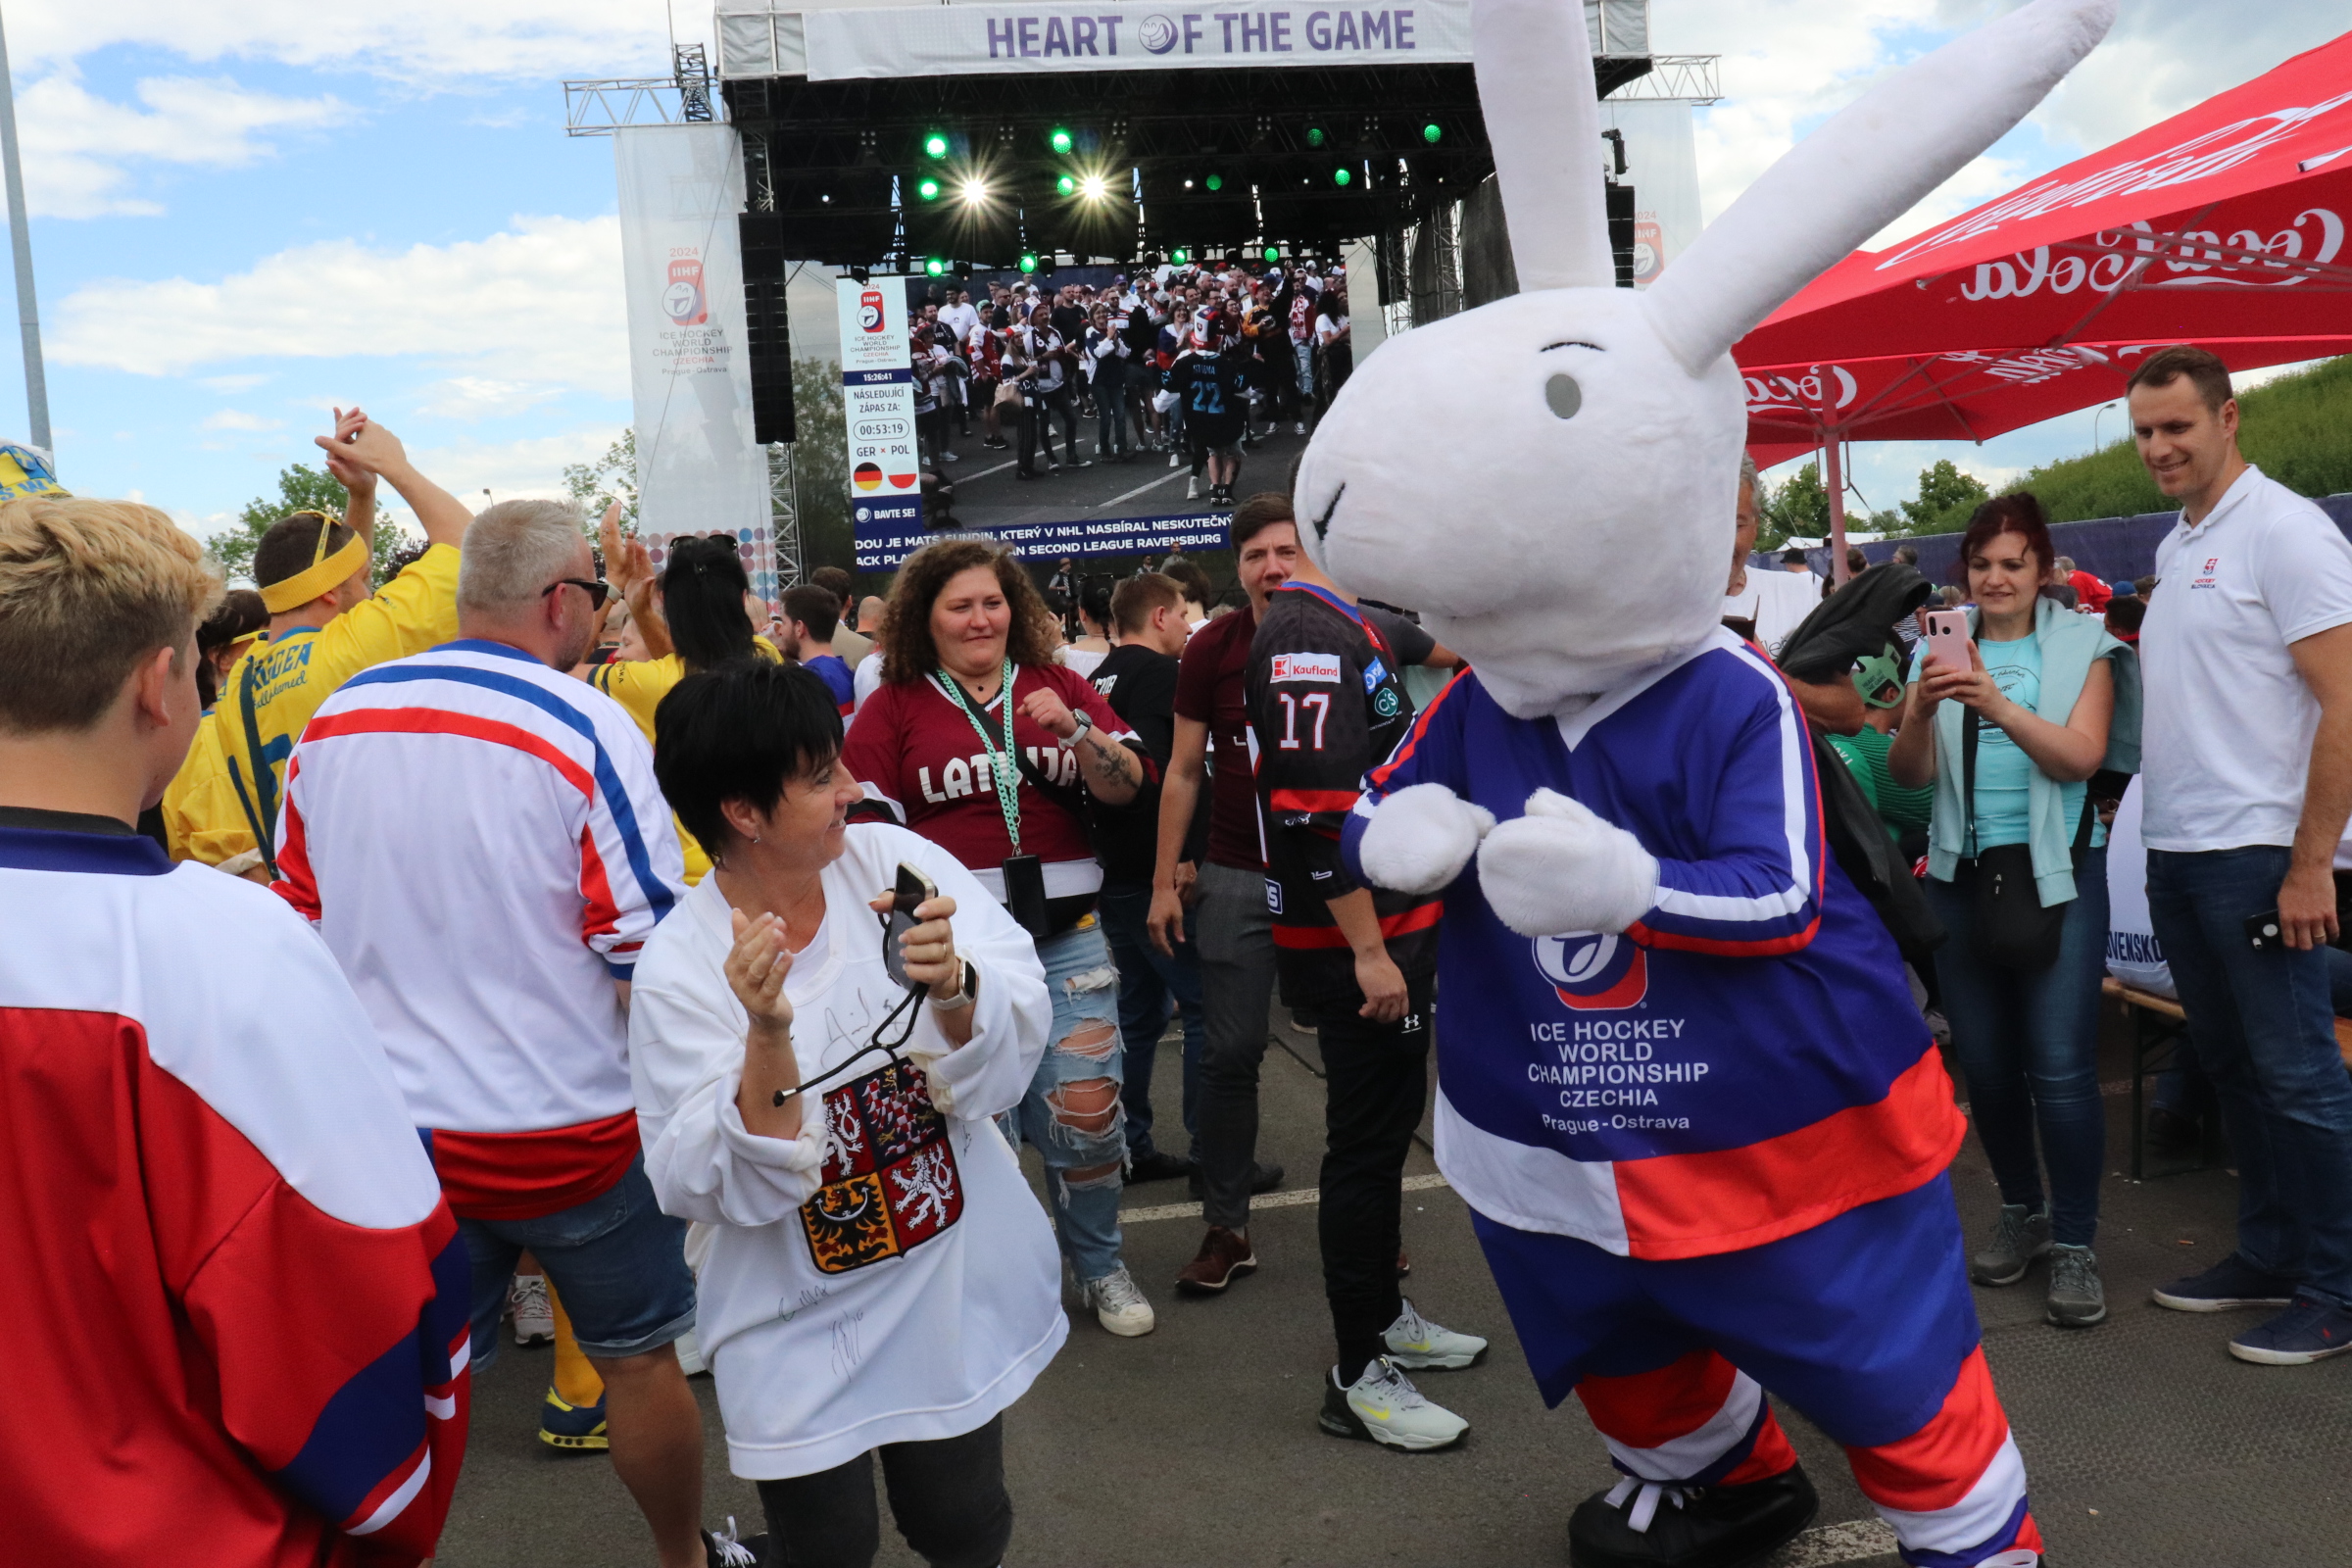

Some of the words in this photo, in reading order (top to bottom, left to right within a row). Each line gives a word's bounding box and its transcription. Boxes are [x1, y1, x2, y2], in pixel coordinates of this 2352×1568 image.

[987, 16, 1123, 58] HEART
[1213, 12, 1293, 53] THE
[1305, 10, 1416, 51] GAME
[1634, 211, 1657, 220] 024
[669, 247, 699, 257] 2024
[672, 266, 700, 277] IIHF
[660, 331, 677, 340] ICE
[679, 329, 723, 339] HOCKEY
[672, 338, 711, 348] WORLD
[652, 346, 733, 357] CHAMPIONSHIP
[672, 356, 715, 366] CZECHIA
[862, 372, 893, 382] 15:26:41
[854, 385, 905, 400] NÁSLEDUJÍCÍ
[1190, 380, 1225, 415] 22
[858, 402, 886, 414] ZÁPAS
[887, 403, 902, 412] ZA:
[859, 423, 904, 435] 00:53:19
[856, 446, 876, 457] GER
[891, 445, 910, 455] POL
[873, 509, 901, 520] BAVTE
[902, 508, 916, 518] SE!
[885, 537, 902, 548] JE
[905, 534, 941, 547] MATS
[1000, 525, 1042, 540] KTERÝ
[1044, 527, 1054, 538] V
[1056, 526, 1084, 537] NHL
[1086, 520, 1150, 535] NASBÍRAL
[1152, 514, 1233, 531] NESKUTEČNÝ
[1028, 542, 1081, 556] SECOND
[1083, 538, 1134, 552] LEAGUE
[1137, 533, 1222, 548] RAVENSBURG
[1293, 664, 1338, 677] Kaufland
[1279, 691, 1331, 751] 17
[1531, 1022, 1566, 1042] ICE
[1574, 1018, 1686, 1041] HOCKEY
[1558, 1042, 1653, 1063] WORLD
[1528, 1062, 1709, 1085] CHAMPIONSHIP
[1559, 1089, 1659, 1107] CZECHIA
